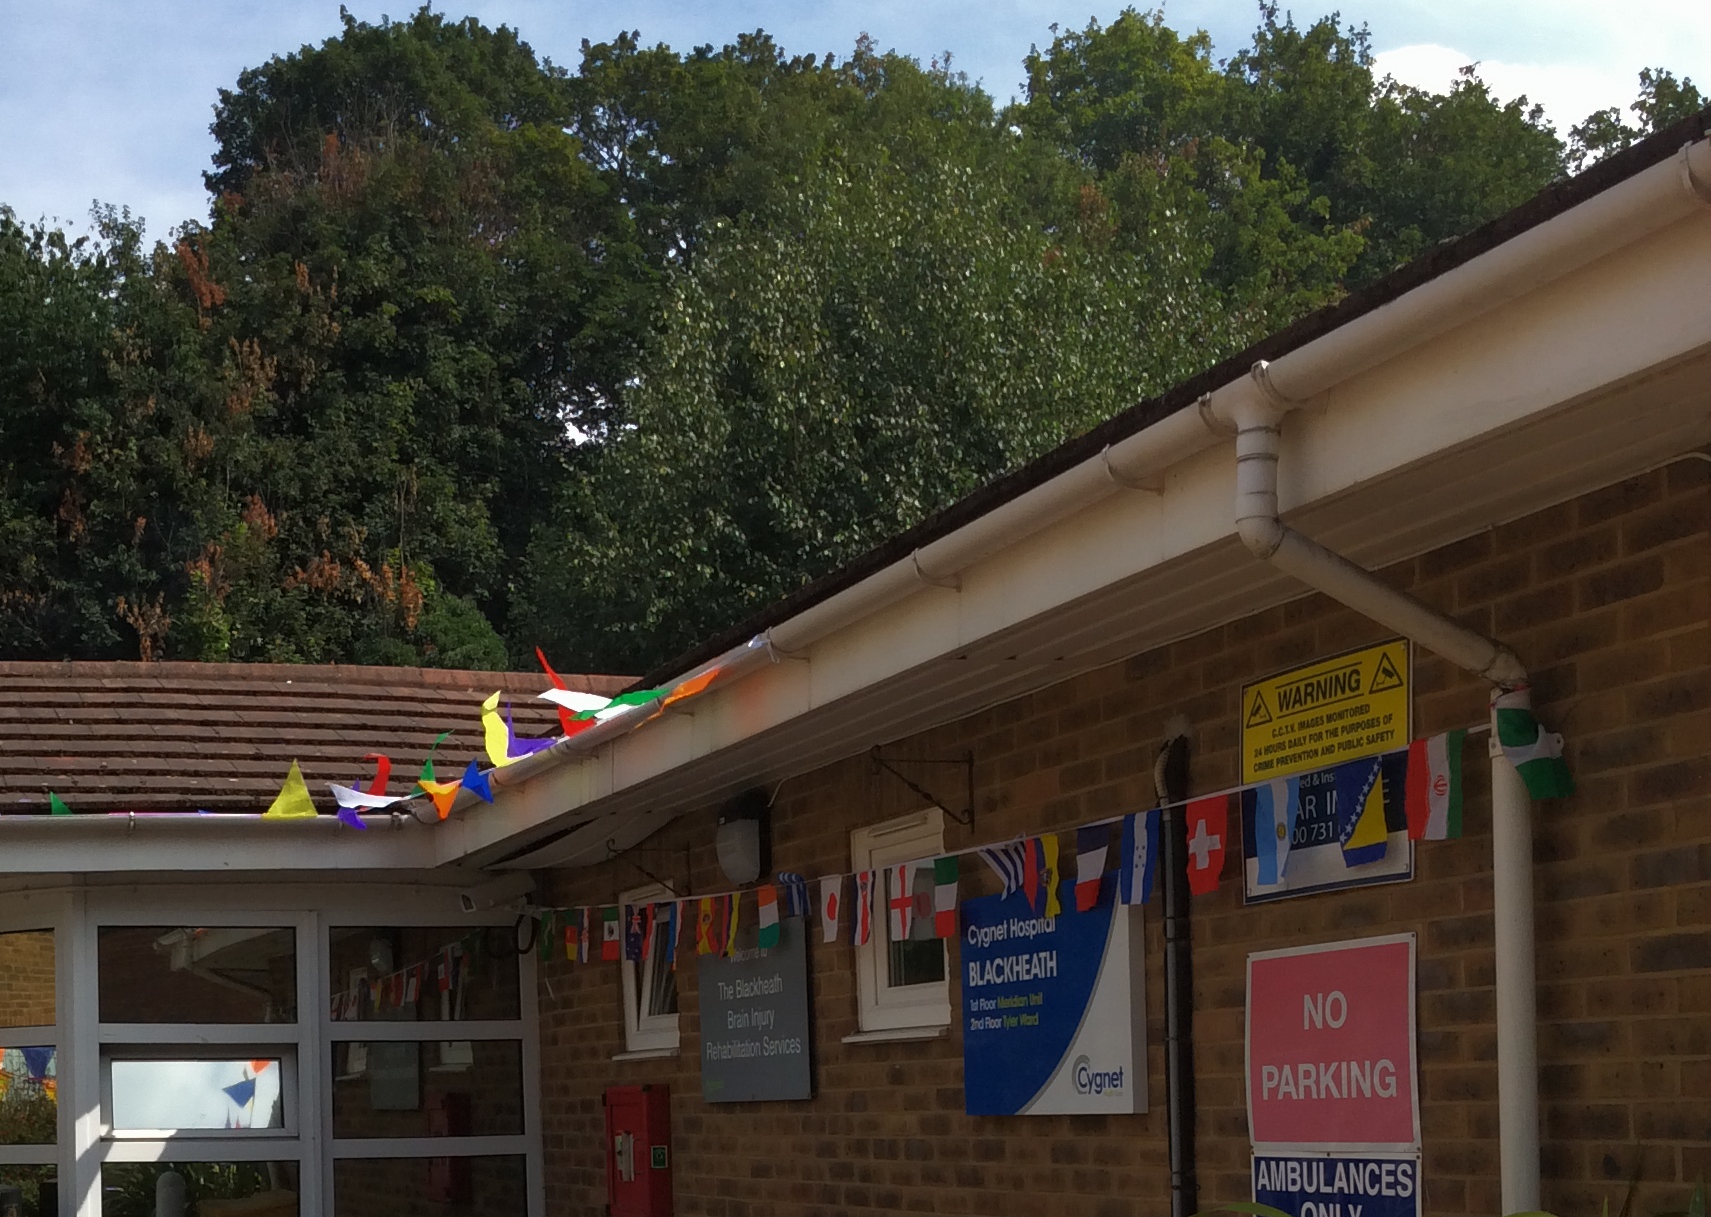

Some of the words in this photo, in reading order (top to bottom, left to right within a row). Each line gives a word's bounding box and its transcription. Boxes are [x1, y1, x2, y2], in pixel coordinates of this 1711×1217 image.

[1278, 668, 1361, 713] WARNING
[1298, 714, 1325, 732] IMAGES
[1326, 703, 1371, 723] MONITORED
[1253, 758, 1274, 774] CRIME
[1276, 749, 1319, 767] PREVENTION
[1320, 744, 1336, 757] AND
[1337, 735, 1365, 752] PUBLIC
[1366, 728, 1395, 746] SAFETY
[1254, 748, 1263, 759] 24
[1264, 741, 1287, 757] HOURS
[1288, 734, 1308, 751] DAILY
[1309, 730, 1323, 746] FOR
[1325, 725, 1339, 740] THE
[1341, 715, 1381, 736] PURPOSES
[1383, 713, 1394, 726] OF
[1310, 821, 1333, 840] 731
[968, 920, 1008, 948] Cygnet
[1010, 917, 1056, 940] Hospital
[968, 950, 1058, 987] BLACKHEATH
[718, 982, 734, 1001] The
[735, 973, 784, 999] Blackheath
[970, 999, 979, 1012] 1st
[979, 997, 997, 1011] Floor
[997, 994, 1028, 1009] Meridian
[1029, 992, 1043, 1006] Unit
[727, 1009, 749, 1030] Brain
[750, 1007, 775, 1031] Injury
[970, 1017, 985, 1031] 2nd
[985, 1016, 1003, 1029] Floor
[1003, 1014, 1019, 1031] Tyler
[1019, 1012, 1039, 1026] Ward
[1303, 990, 1348, 1031] NO
[706, 1039, 761, 1061] Rehabilitation
[762, 1034, 801, 1057] Services
[1077, 1065, 1124, 1095] Cygnet
[1261, 1058, 1398, 1101] PARKING
[1257, 1160, 1413, 1198] AMBULANCES
